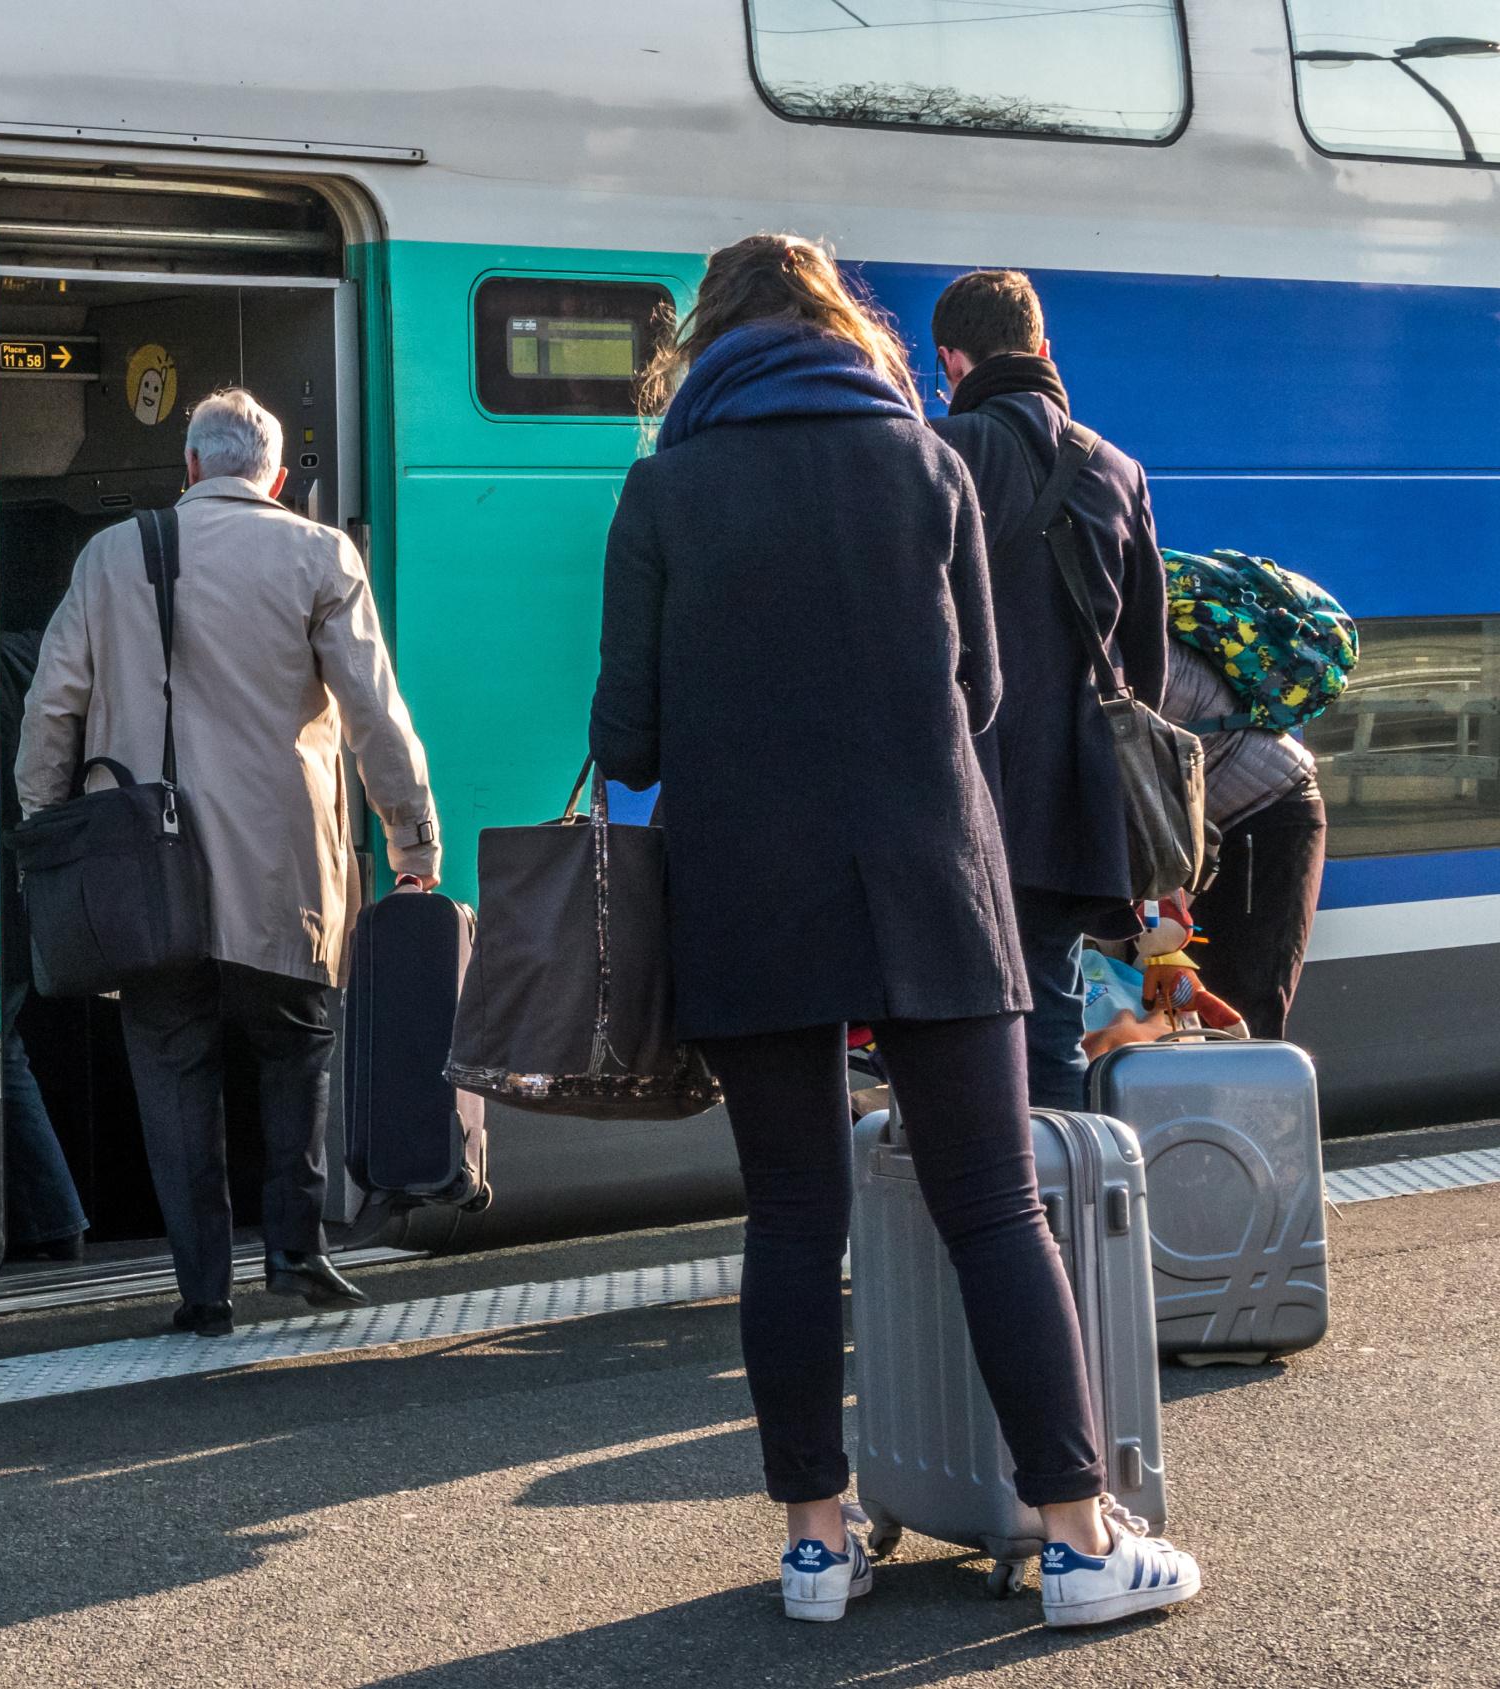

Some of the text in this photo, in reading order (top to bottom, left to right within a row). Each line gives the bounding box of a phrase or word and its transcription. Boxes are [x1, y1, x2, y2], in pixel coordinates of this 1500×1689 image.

[3, 345, 27, 354] Places
[3, 354, 15, 367] 11
[27, 354, 42, 367] 58
